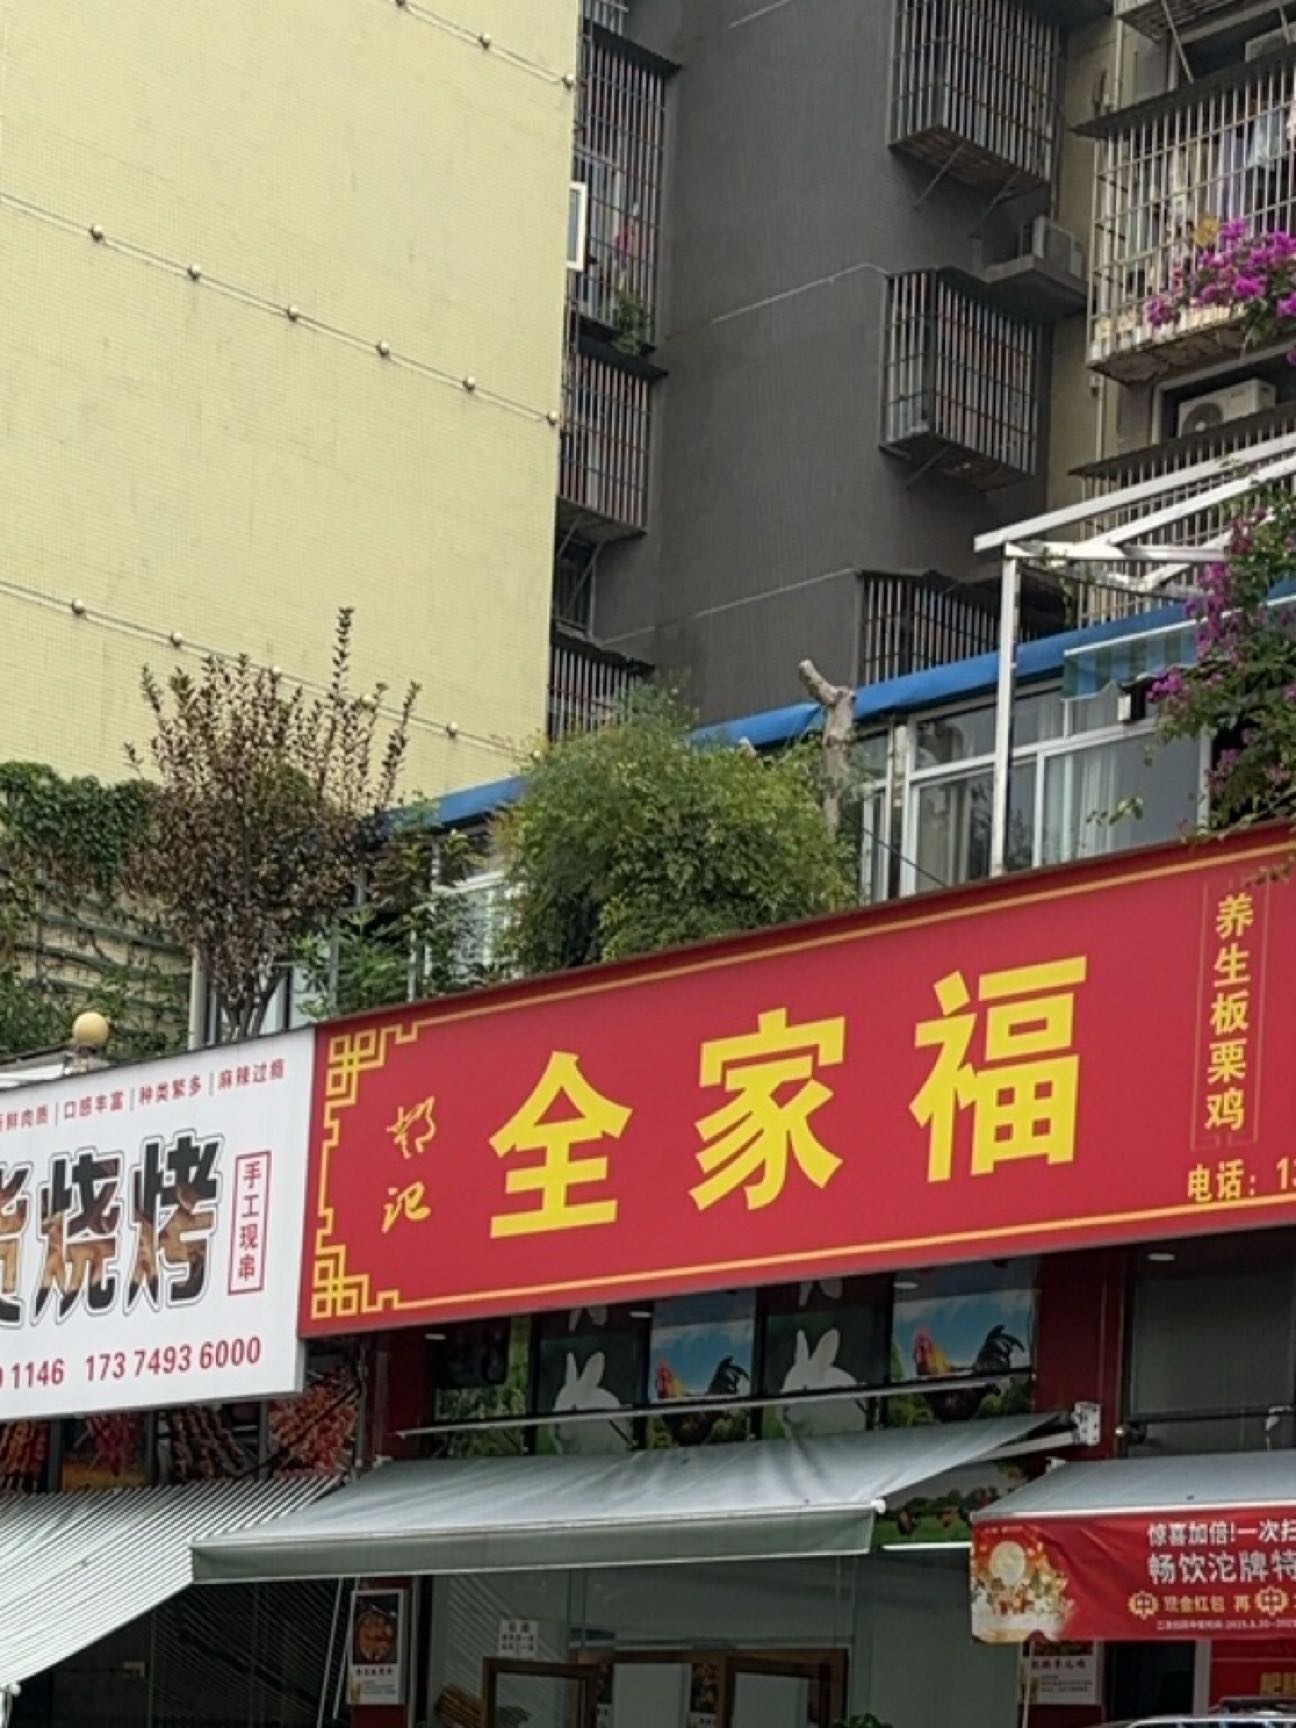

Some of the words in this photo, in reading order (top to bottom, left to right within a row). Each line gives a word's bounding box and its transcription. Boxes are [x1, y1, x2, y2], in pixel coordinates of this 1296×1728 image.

[1204, 892, 1254, 1131] 养生板栗鸡
[64, 1090, 123, 1120] 口感丰富
[138, 1074, 202, 1105] 种类繁多
[218, 1057, 286, 1091] 麻辣过瘾
[488, 955, 1088, 1240] 全家福
[239, 1160, 262, 1281] 手工现串
[1188, 1159, 1256, 1202] 电话：
[11, 1357, 65, 1390] 1146
[85, 1351, 126, 1382] 173
[134, 1344, 193, 1376] 7493
[199, 1336, 261, 1370] 6000
